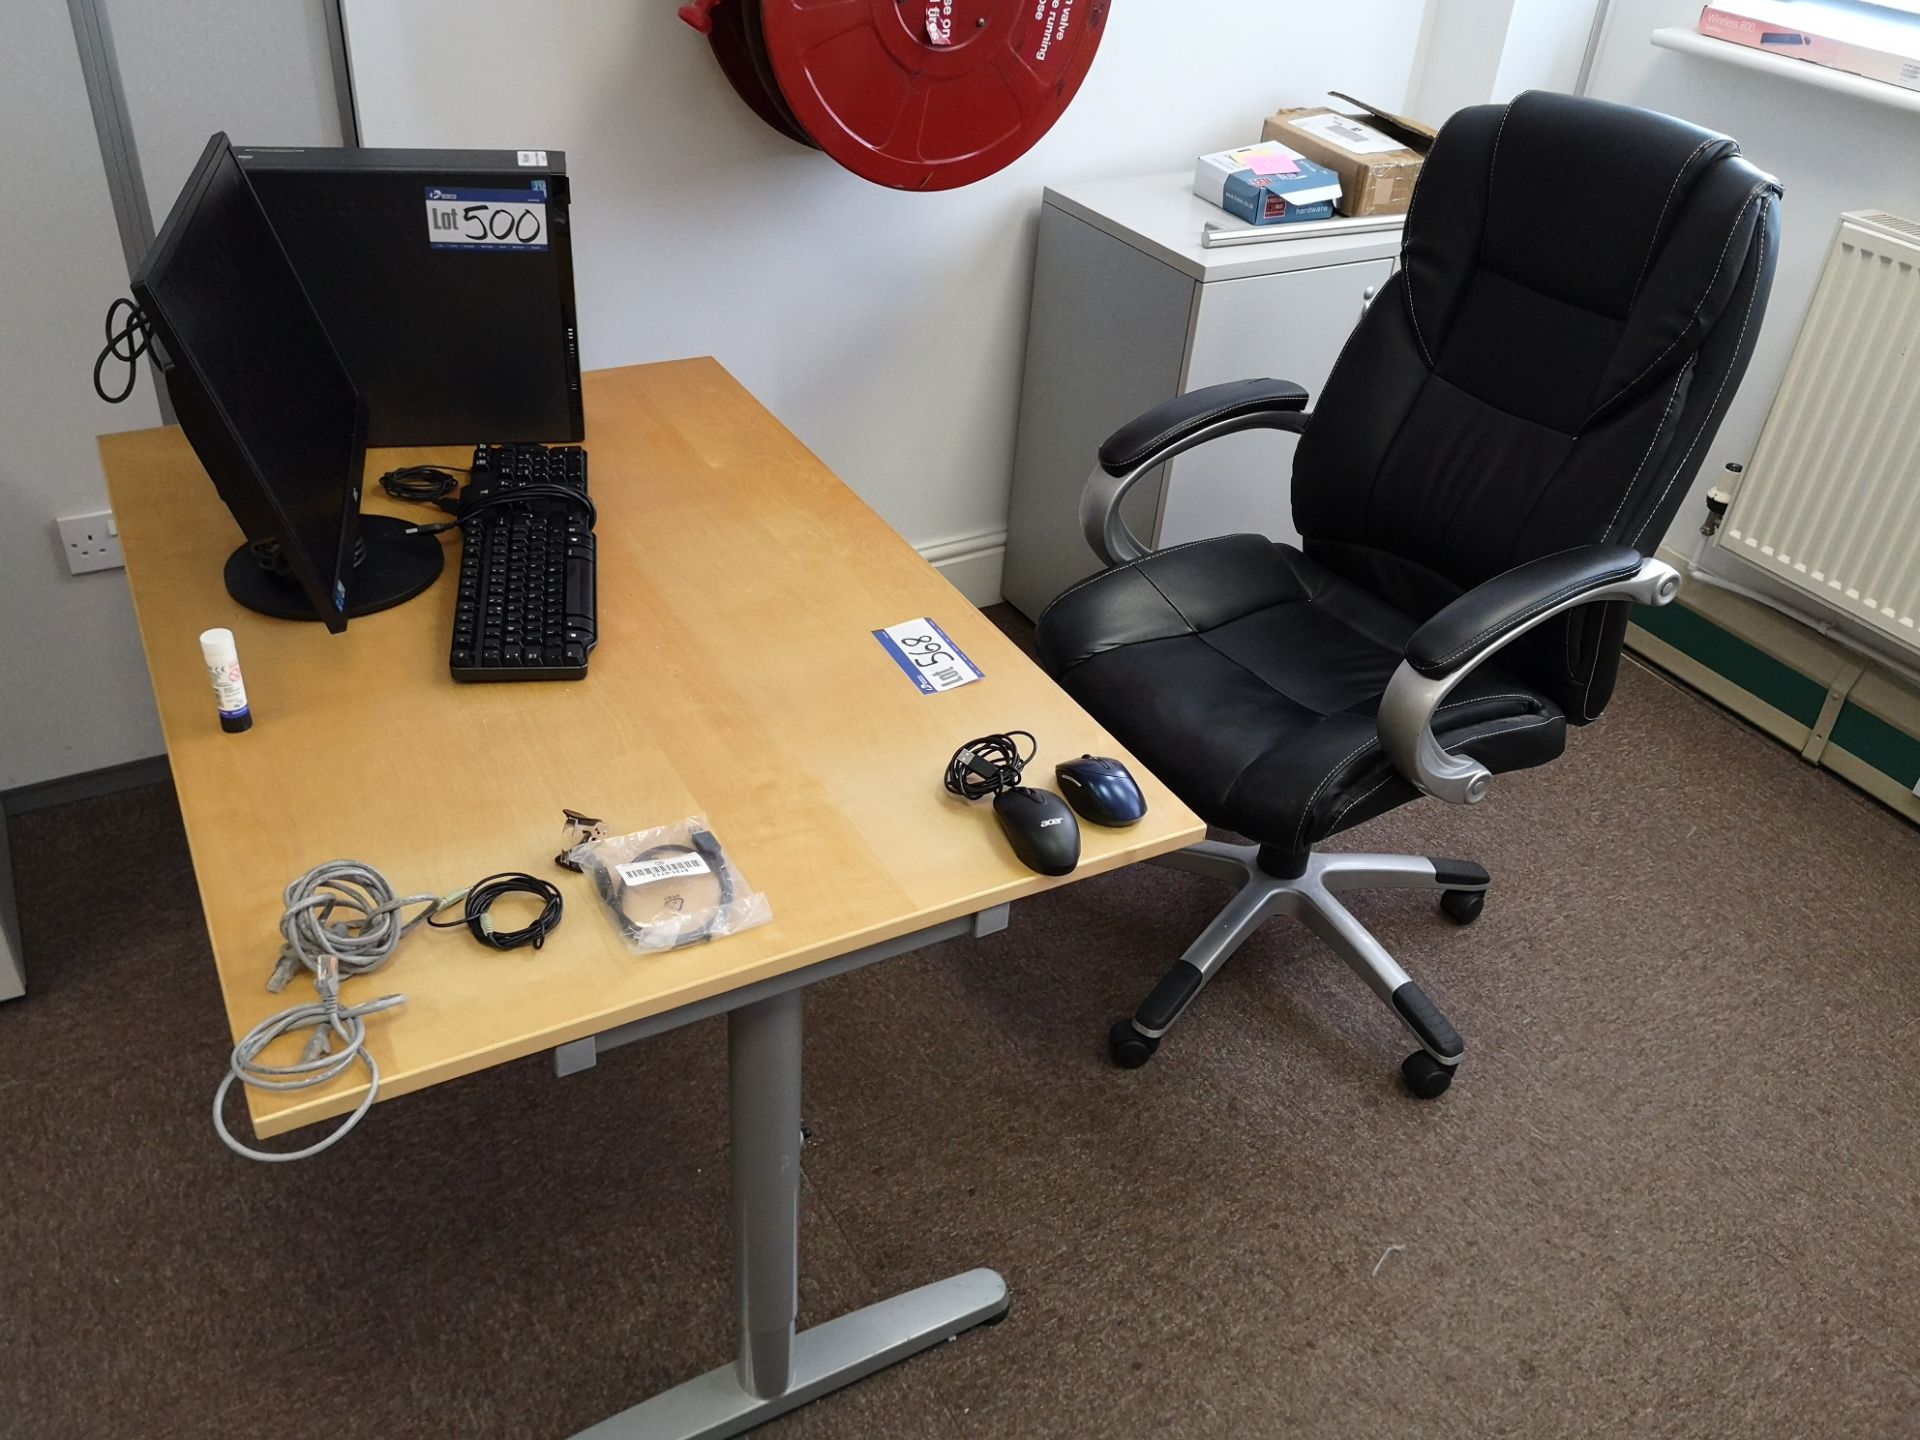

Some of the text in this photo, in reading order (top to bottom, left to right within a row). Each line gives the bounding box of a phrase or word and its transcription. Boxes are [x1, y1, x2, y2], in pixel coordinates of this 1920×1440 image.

[928, 7, 940, 40] fires
[942, 19, 952, 38] on
[1036, 11, 1057, 61] running
[1056, 8, 1071, 41] valve
[1707, 12, 1738, 29] Wireless
[431, 205, 540, 243] Lot 500
[1295, 206, 1328, 216] hardware
[901, 635, 964, 687] Lot 568
[1040, 817, 1063, 828] acer
